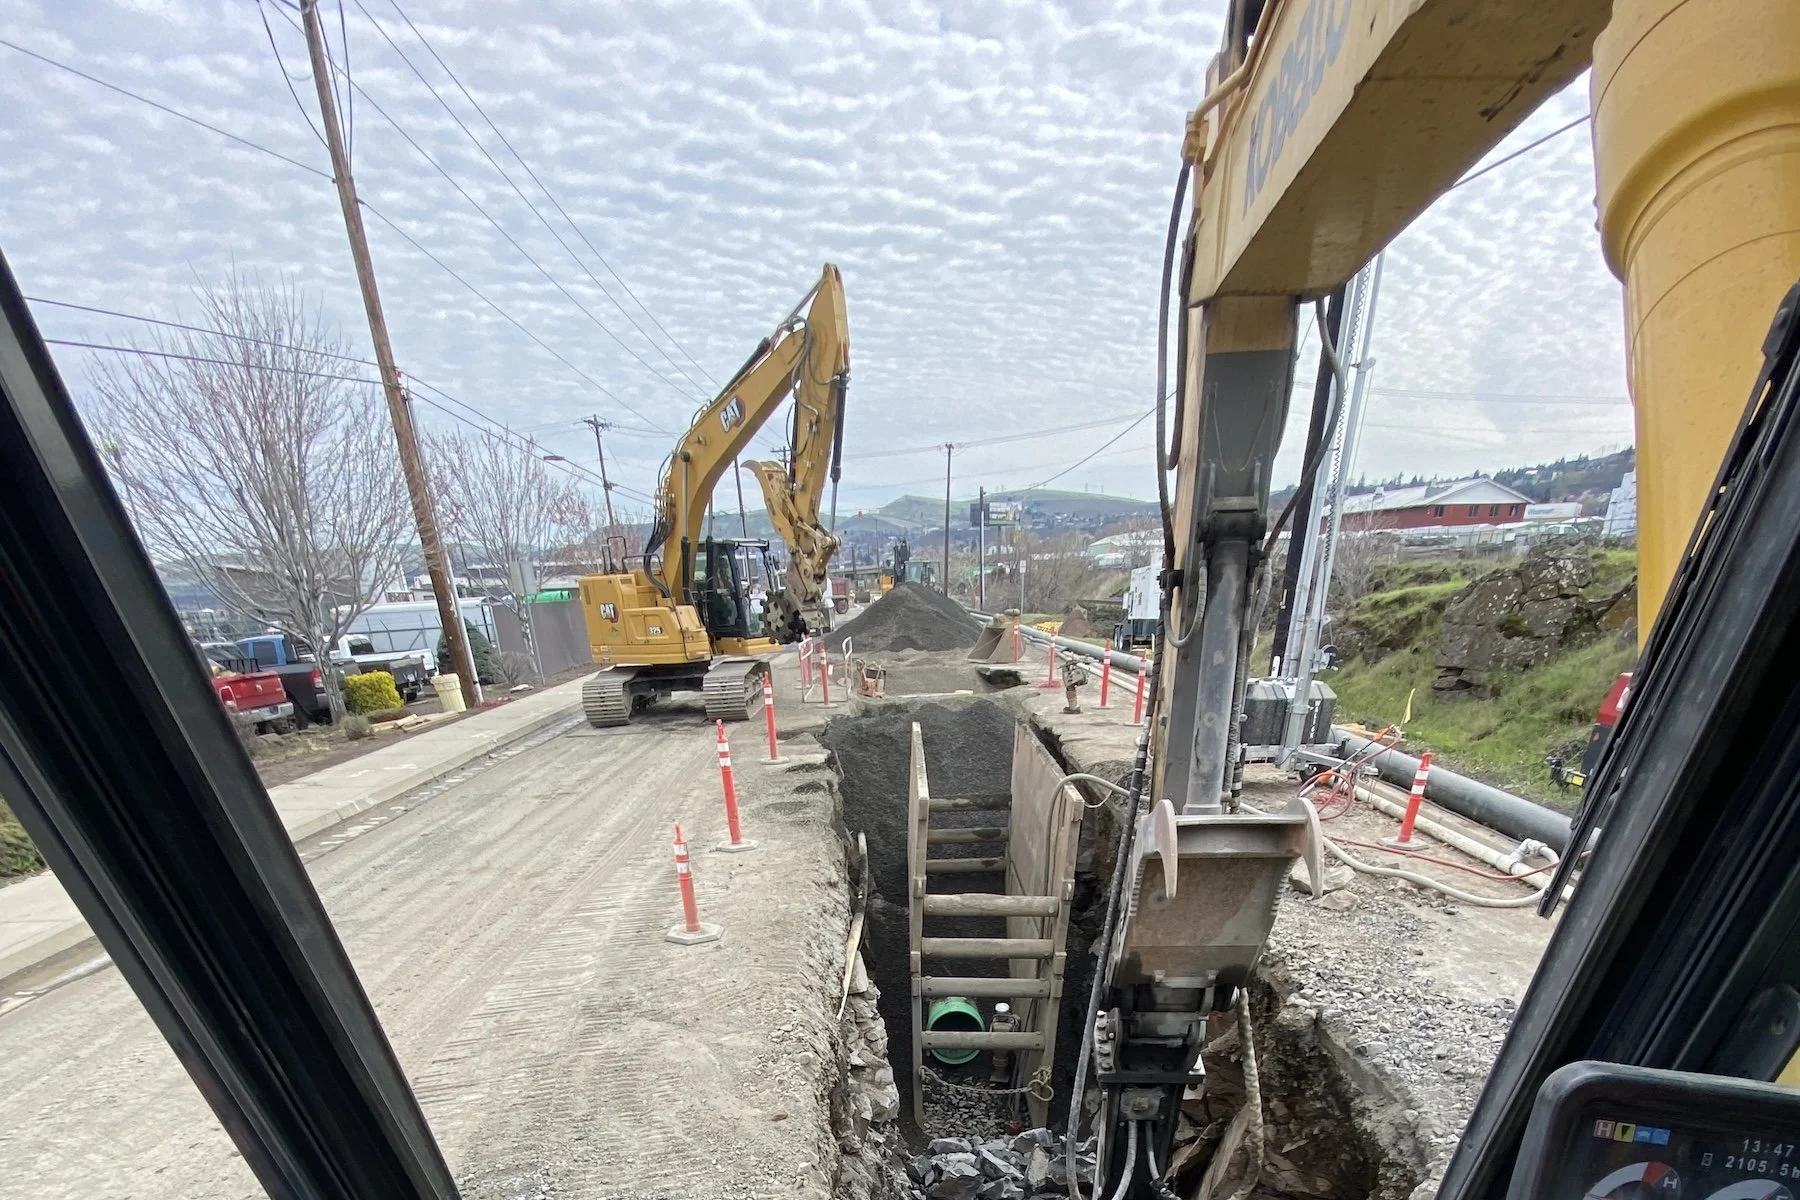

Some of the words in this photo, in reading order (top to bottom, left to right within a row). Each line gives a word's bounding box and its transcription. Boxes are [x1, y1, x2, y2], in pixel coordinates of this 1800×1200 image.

[720, 397, 741, 432] CAT
[600, 603, 615, 619] CAT
[1742, 1138, 1795, 1158] 13:47
[1724, 1155, 1800, 1179] 2105.5h
[1662, 1176, 1678, 1190] H
